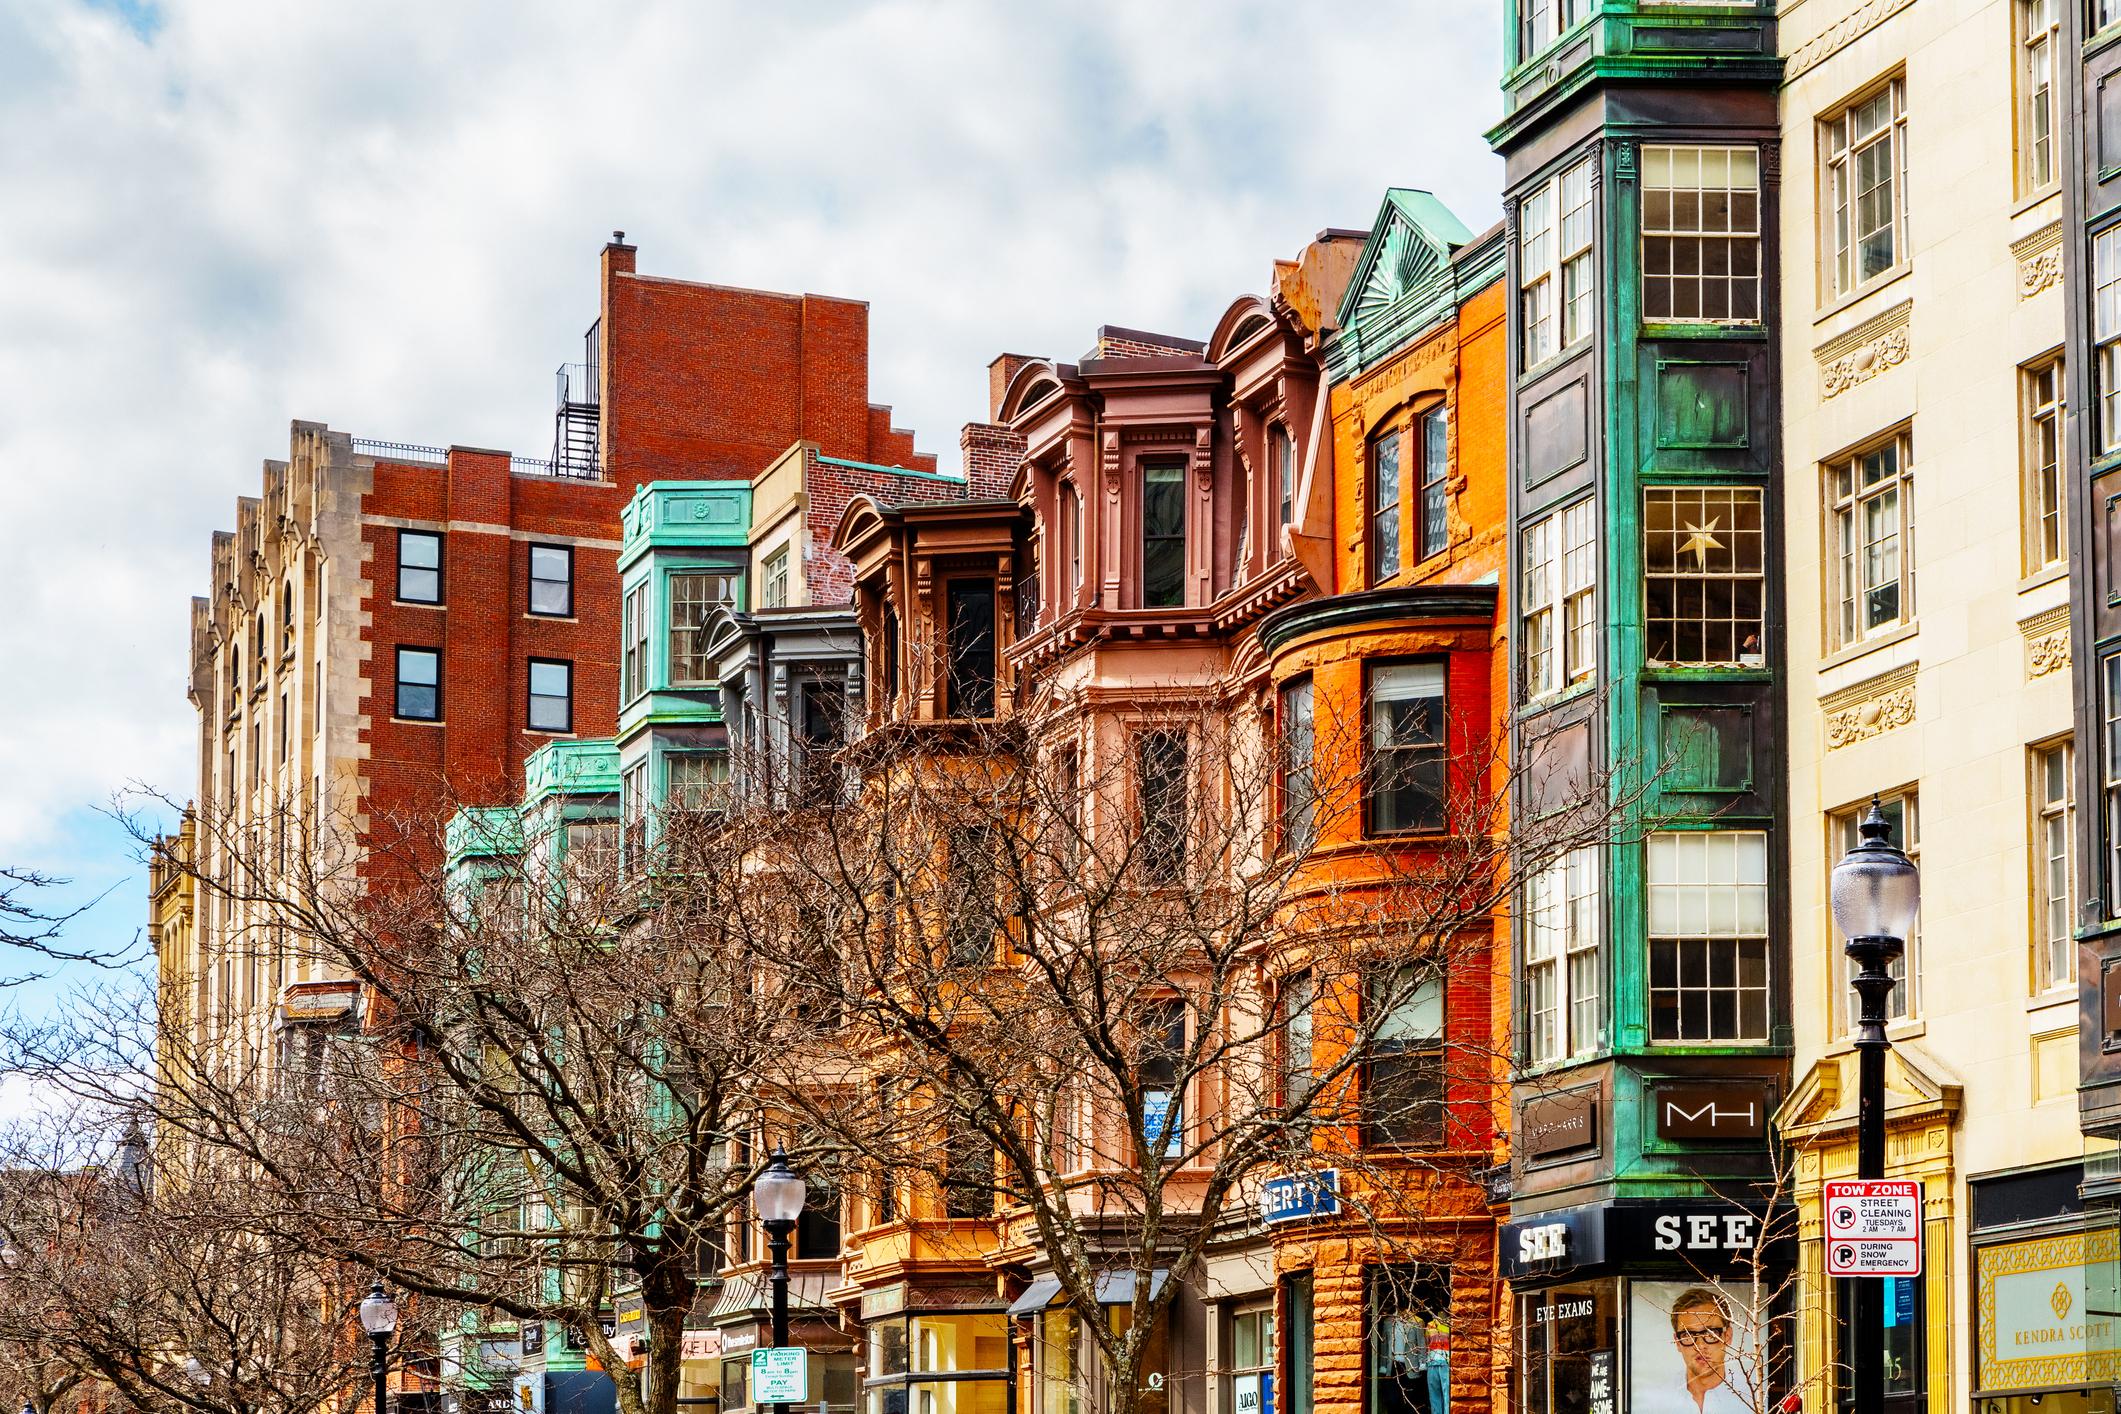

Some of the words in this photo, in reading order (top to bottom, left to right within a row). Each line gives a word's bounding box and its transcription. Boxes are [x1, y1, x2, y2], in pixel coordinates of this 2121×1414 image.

[1666, 1102, 1754, 1127] MH
[1832, 1185, 1866, 1196] TOW
[1870, 1184, 1913, 1196] ZONE
[1860, 1199, 1899, 1207] STREET
[1860, 1209, 1912, 1218] CLEANING
[1655, 1215, 1753, 1251] SEE
[1519, 1223, 1566, 1263] SEE
[1860, 1259, 1909, 1267] EMERGENCY
[1536, 1305, 1555, 1322] EYE
[1558, 1300, 1593, 1319] EXAMS
[2015, 1327, 2065, 1346] KENDRA
[2069, 1321, 2111, 1341] SCOTT
[755, 1351, 767, 1363] 2
